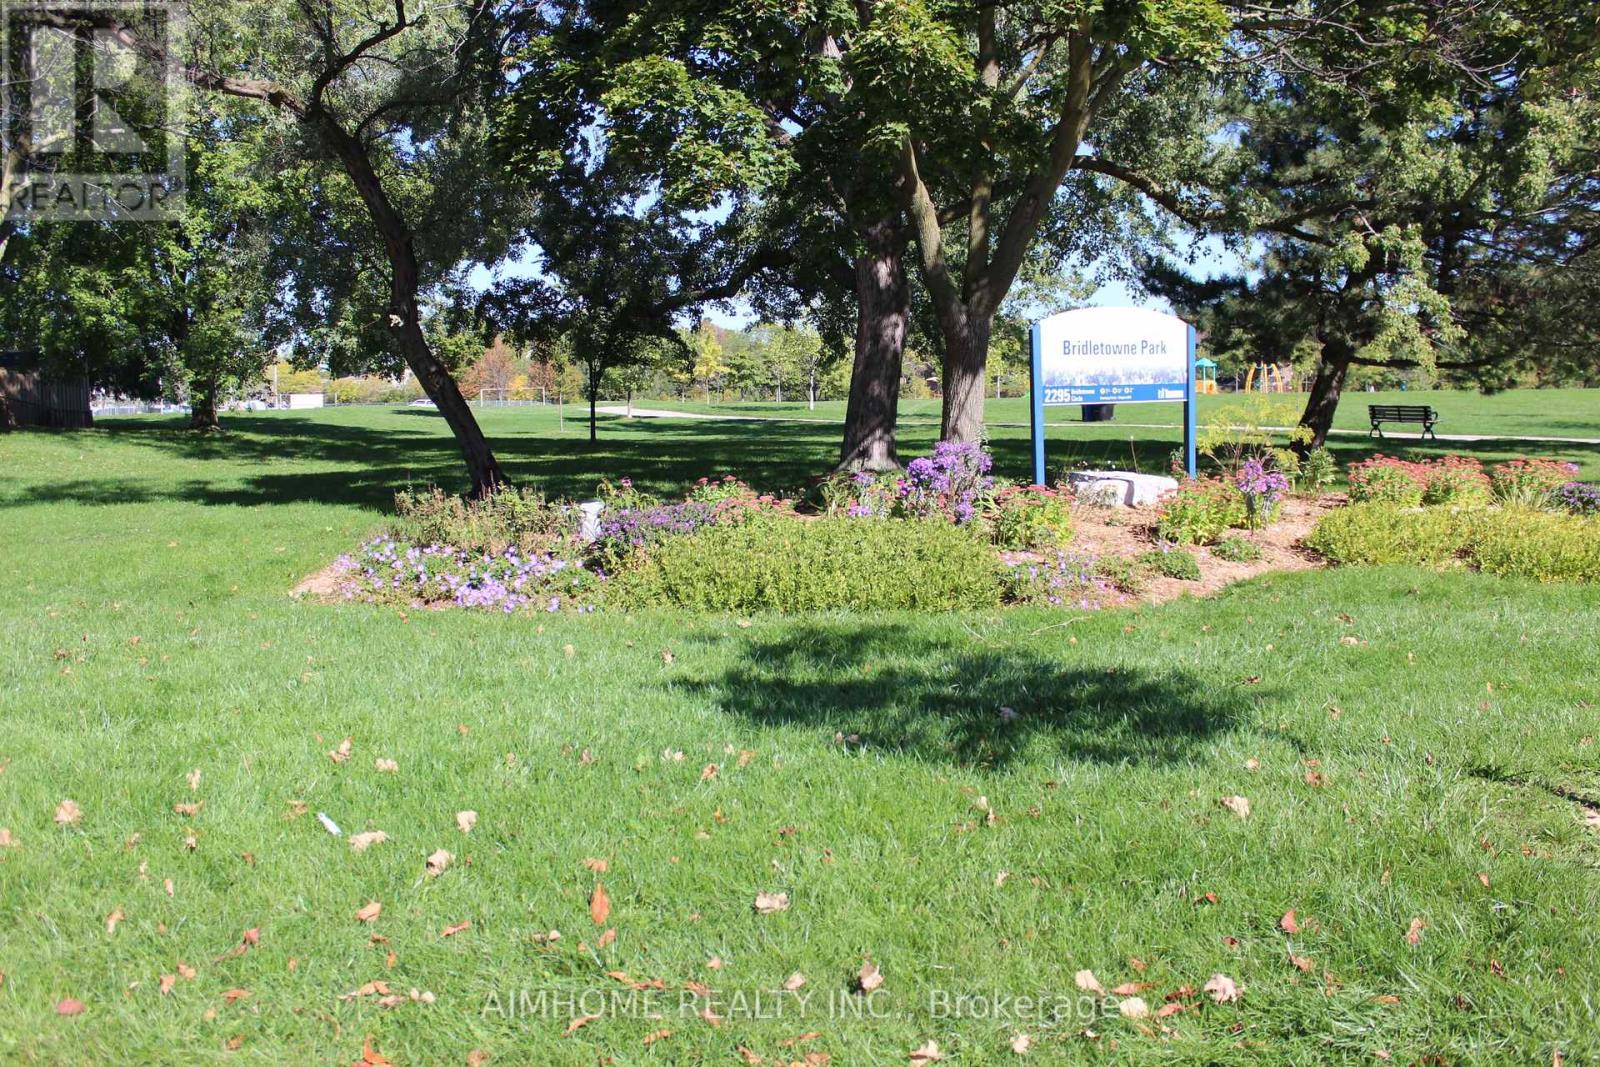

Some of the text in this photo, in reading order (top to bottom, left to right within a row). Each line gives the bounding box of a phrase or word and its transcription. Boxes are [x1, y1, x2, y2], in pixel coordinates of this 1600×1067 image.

[1062, 339, 1167, 356] Bridletowne Park
[1044, 388, 1071, 403] 2295
